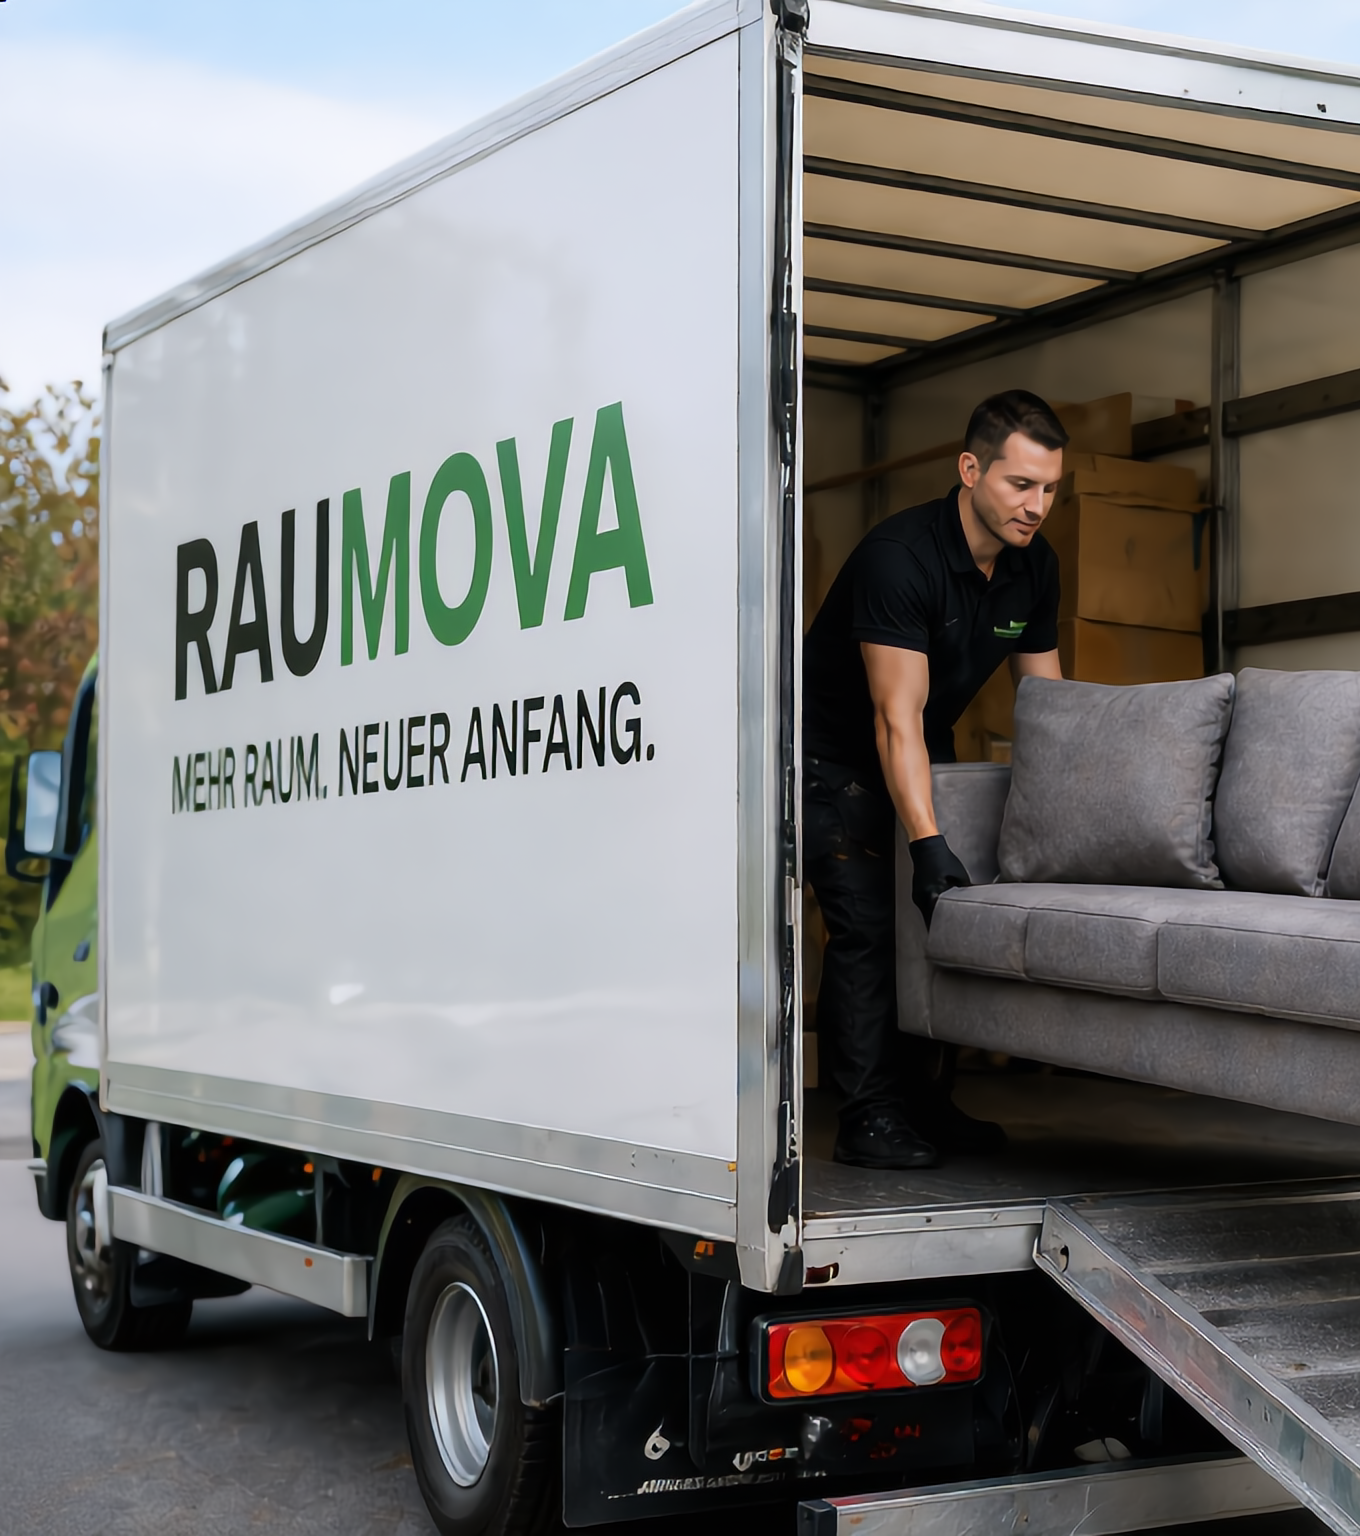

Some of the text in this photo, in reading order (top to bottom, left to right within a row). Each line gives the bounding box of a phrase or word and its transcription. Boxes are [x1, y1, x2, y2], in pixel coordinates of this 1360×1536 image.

[174, 400, 654, 701] RAUMOVA
[172, 681, 655, 814] MEHR RAUM. NEUER ANFANG.
